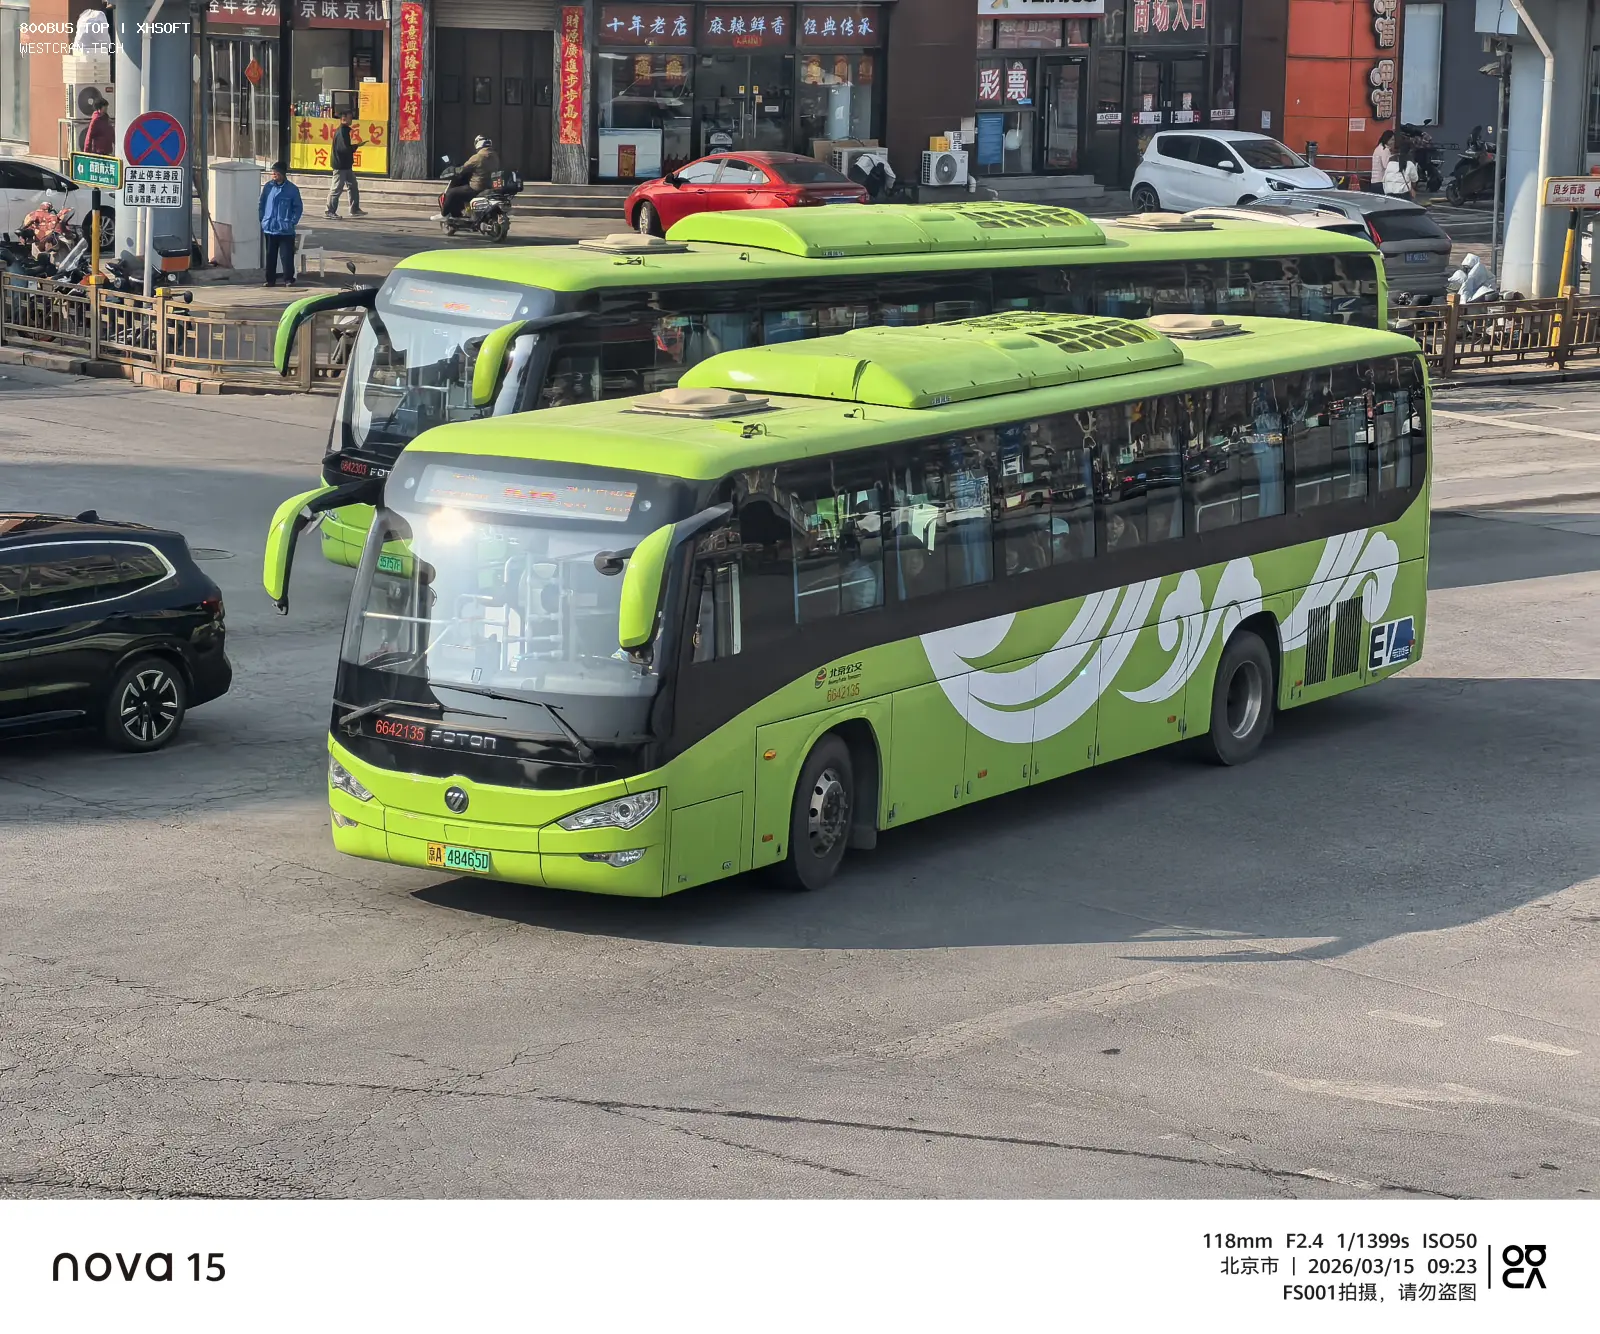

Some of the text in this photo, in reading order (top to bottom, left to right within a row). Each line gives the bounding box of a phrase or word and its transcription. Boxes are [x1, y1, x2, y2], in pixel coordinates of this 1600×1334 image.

[300, 0, 383, 21] 京味京礼
[1133, 0, 1207, 32] 商场入口
[606, 15, 688, 36] 十年老店
[707, 15, 786, 36] 麻辣鲜香
[804, 15, 873, 37] 经典传承
[980, 69, 1027, 99] 彩票
[129, 170, 179, 180] 禁止停车路段
[126, 183, 180, 195] 西潞南大街
[1553, 184, 1586, 195] 良乡西路
[370, 467, 392, 477] FOT
[827, 683, 860, 702] 6642135
[375, 719, 497, 749] 6642135 FOTON
